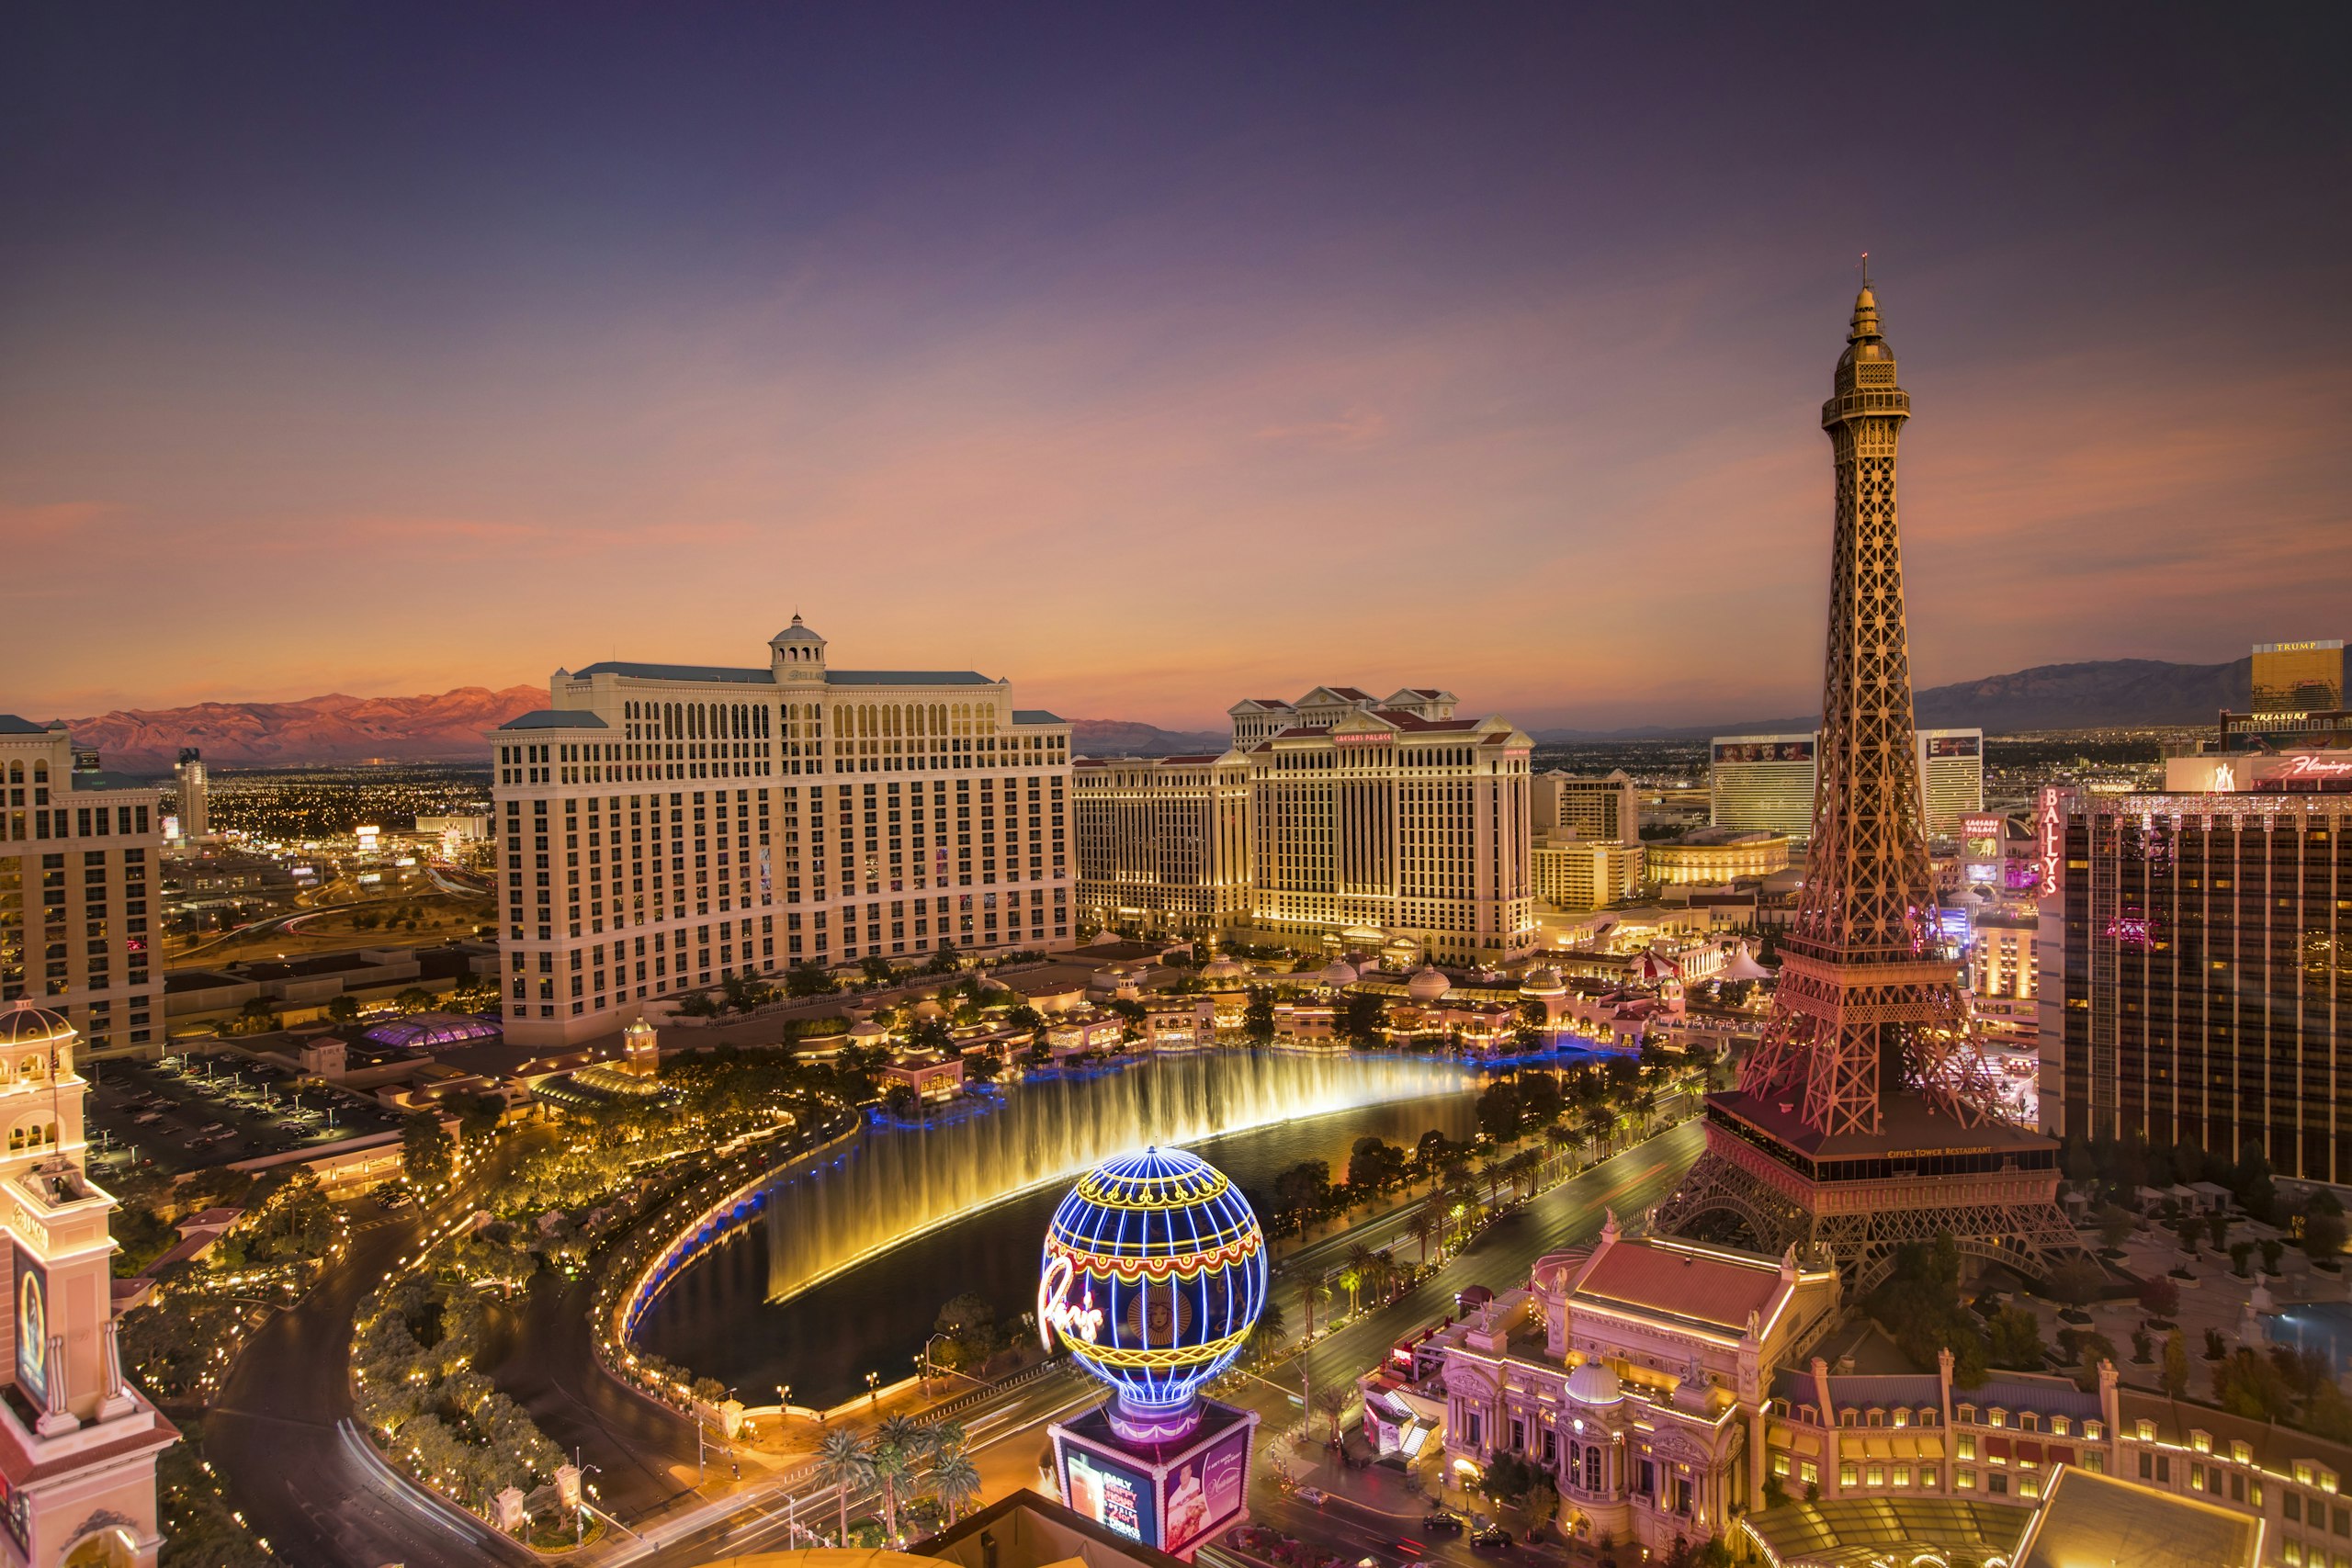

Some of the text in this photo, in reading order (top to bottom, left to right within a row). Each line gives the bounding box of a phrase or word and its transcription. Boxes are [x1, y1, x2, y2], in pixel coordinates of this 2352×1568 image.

[2277, 643, 2316, 651] TRUMP
[2252, 713, 2308, 721] TREASURE
[1364, 733, 1391, 741] PALACE
[2291, 756, 2352, 774] Flamingo
[1888, 1145, 1992, 1158] EIFFEL TOWER RESTAURANT
[1037, 1255, 1103, 1350] Paris
[1102, 1472, 1132, 1490] DAILY
[1104, 1490, 1135, 1508] HOUR
[1105, 1483, 1137, 1501] HAPPY
[1108, 1517, 1141, 1540] DRINKS
